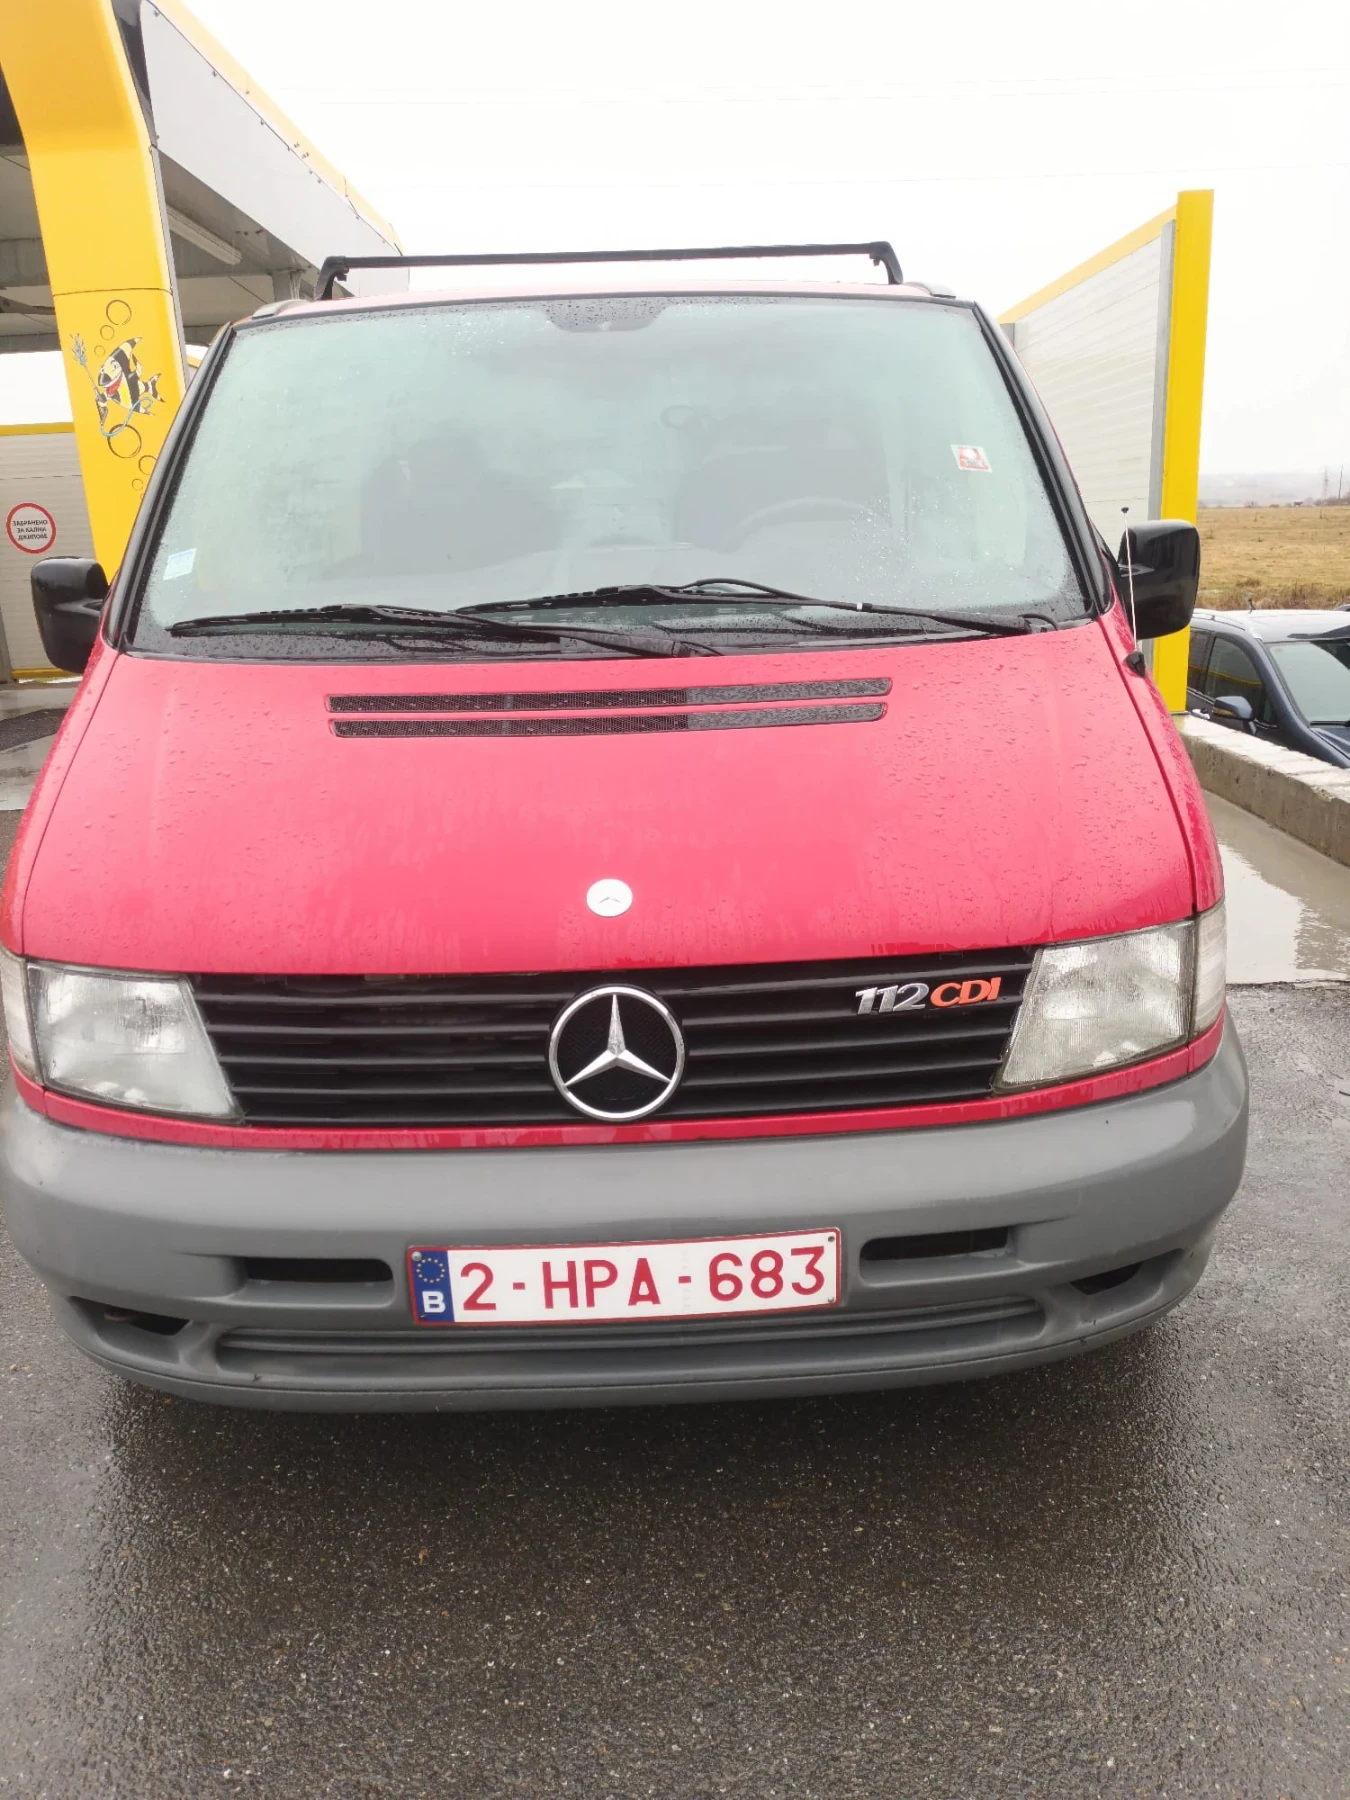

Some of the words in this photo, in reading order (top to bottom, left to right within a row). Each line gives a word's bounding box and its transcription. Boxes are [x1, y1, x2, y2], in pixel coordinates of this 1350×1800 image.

[855, 982, 929, 1015] 112
[930, 976, 1001, 1008] CDI
[460, 1246, 826, 1311] 2-HPA-683
[421, 1291, 446, 1314] B
